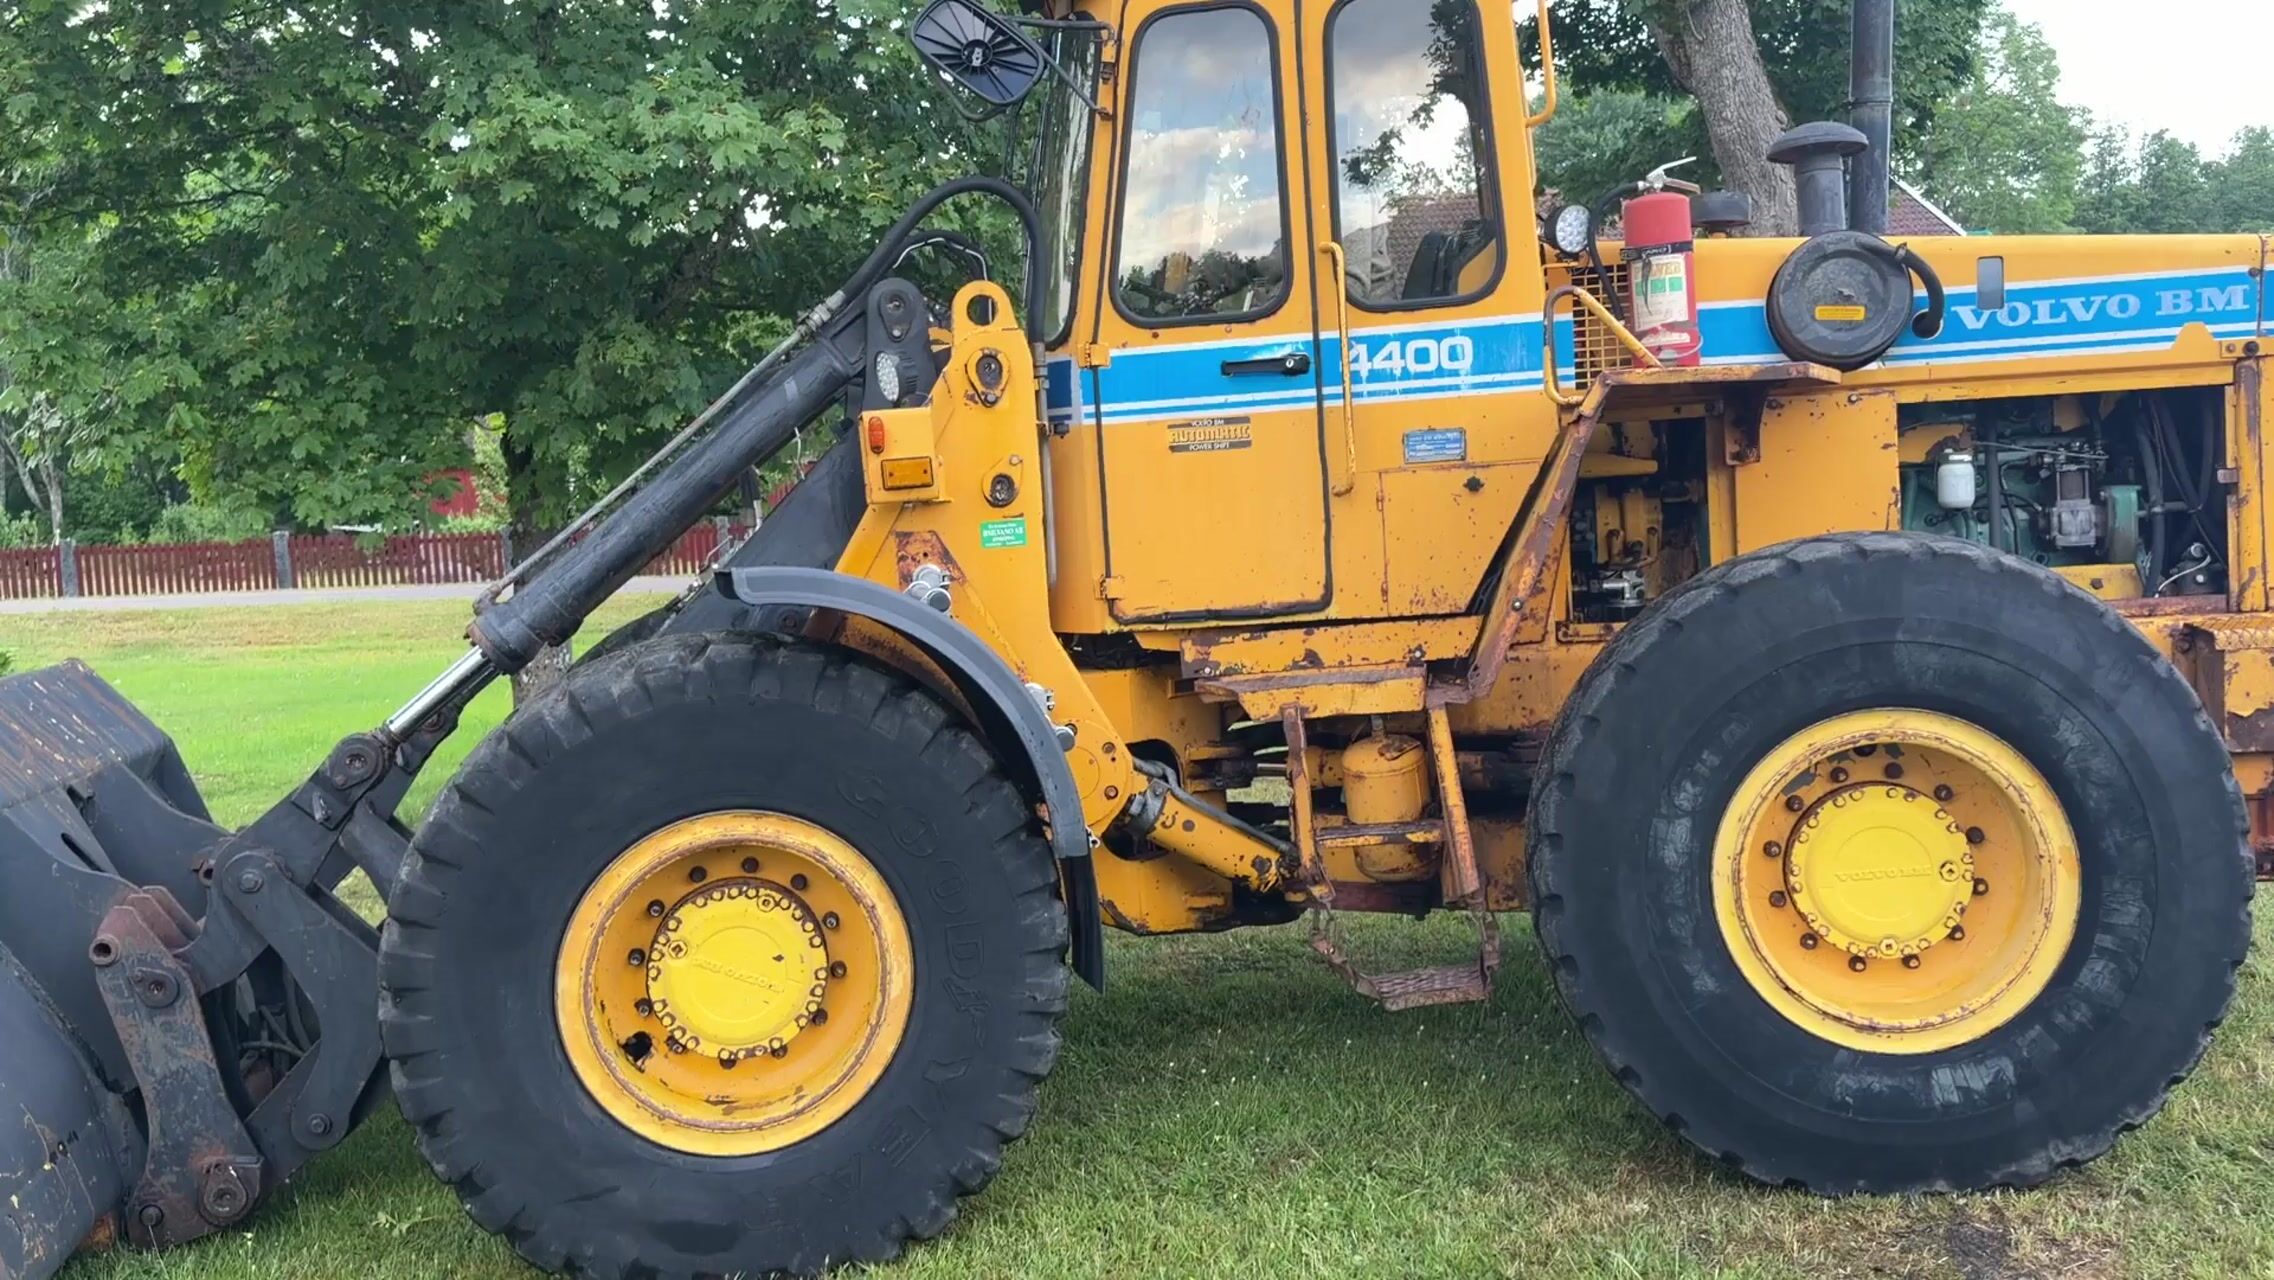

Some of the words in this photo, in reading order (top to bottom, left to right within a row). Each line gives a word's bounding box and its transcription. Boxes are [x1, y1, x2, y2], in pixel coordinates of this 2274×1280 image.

[1951, 293, 2141, 330] VOLVO
[2155, 285, 2250, 316] BM
[1340, 336, 1473, 376] 4400
[1191, 419, 1213, 427] VOLVO
[1168, 425, 1250, 443] AUTOMATIC
[1189, 443, 1212, 451] POWER
[1213, 441, 1229, 449] SHIFT
